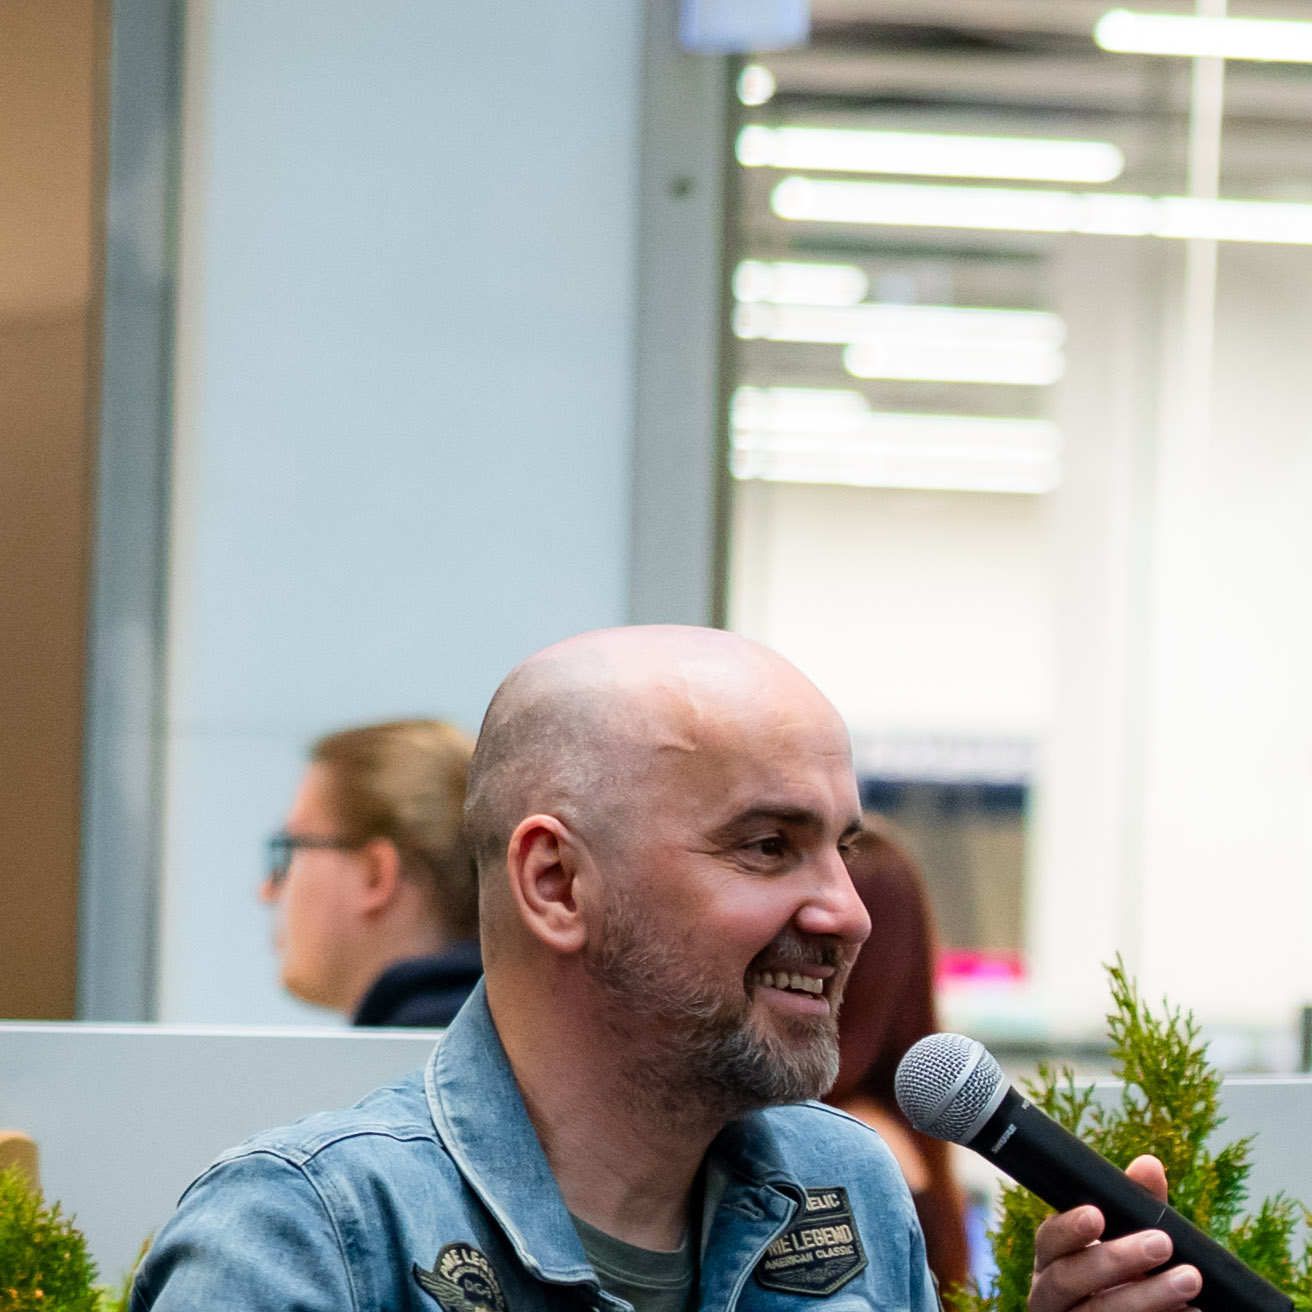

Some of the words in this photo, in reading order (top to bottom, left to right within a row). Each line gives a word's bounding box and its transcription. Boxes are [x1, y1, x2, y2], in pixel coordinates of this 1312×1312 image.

[767, 1235, 793, 1257] ME
[791, 1224, 854, 1251] LEGEND
[765, 1252, 814, 1270] AMERICAN
[815, 1245, 855, 1259] CLASSIC
